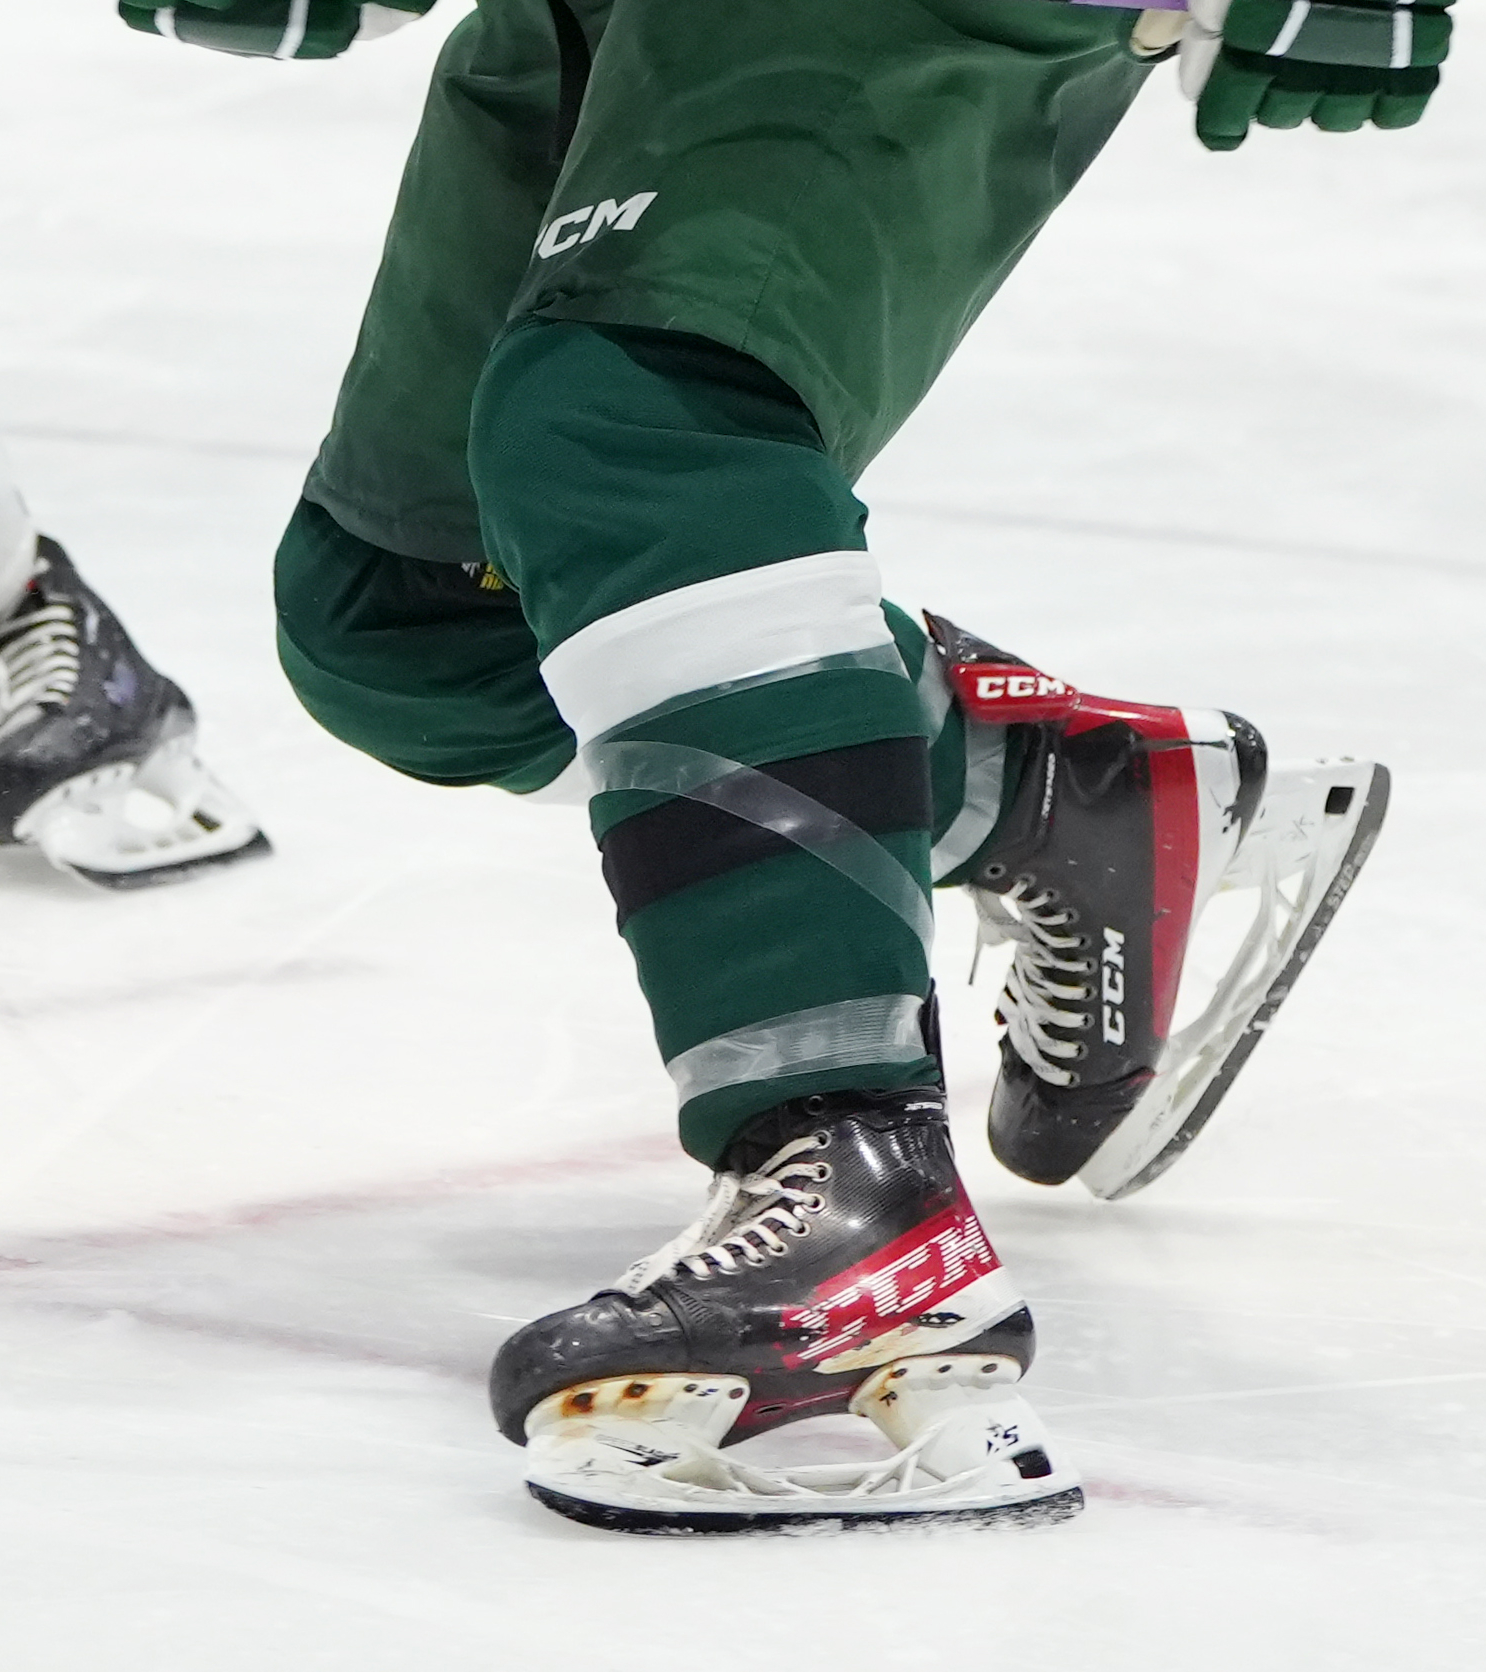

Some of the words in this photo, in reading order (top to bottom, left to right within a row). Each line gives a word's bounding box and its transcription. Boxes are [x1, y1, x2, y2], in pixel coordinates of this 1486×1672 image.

[530, 191, 659, 260] CM
[1101, 925, 1127, 1048] CCM
[788, 1213, 984, 1362] CCM
